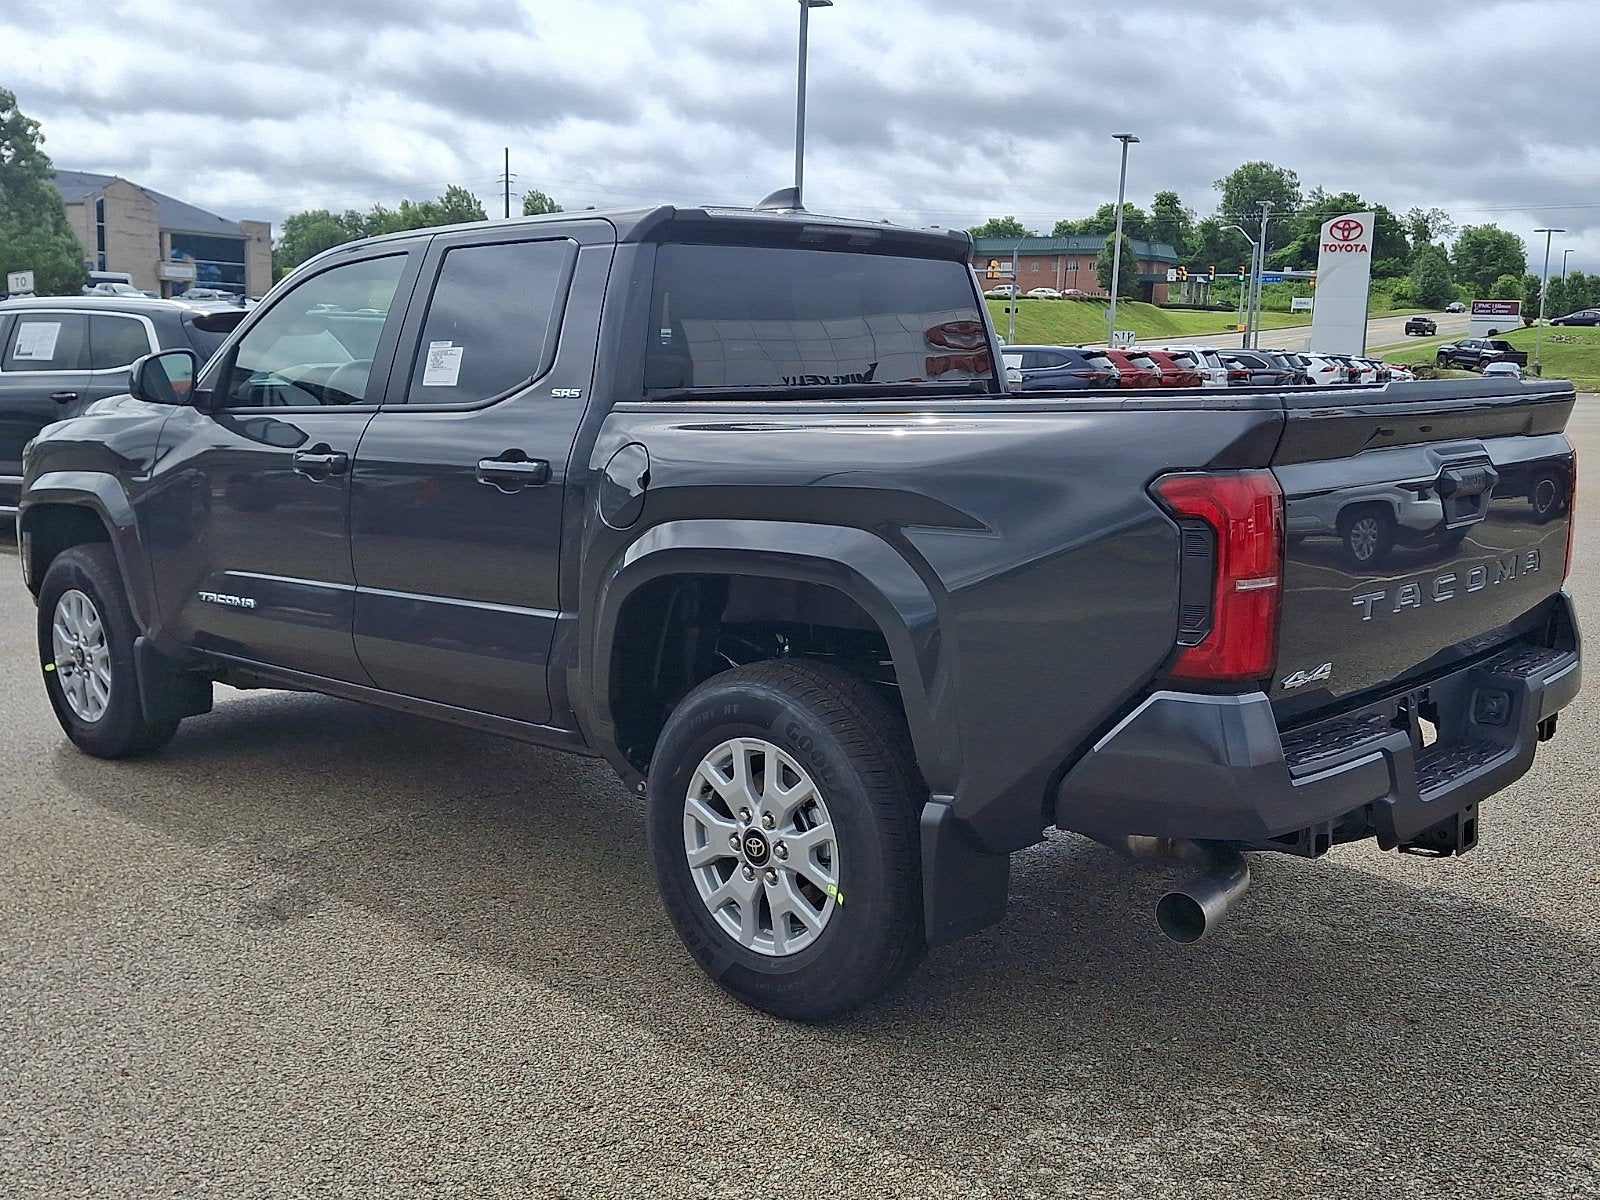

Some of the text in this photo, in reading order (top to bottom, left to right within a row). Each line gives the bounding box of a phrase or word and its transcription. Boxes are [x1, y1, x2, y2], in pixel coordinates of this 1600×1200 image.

[1322, 243, 1368, 253] TOYOTA
[550, 387, 582, 399] SR5
[1352, 548, 1541, 621] TACOMA
[198, 591, 256, 608] TACOMA
